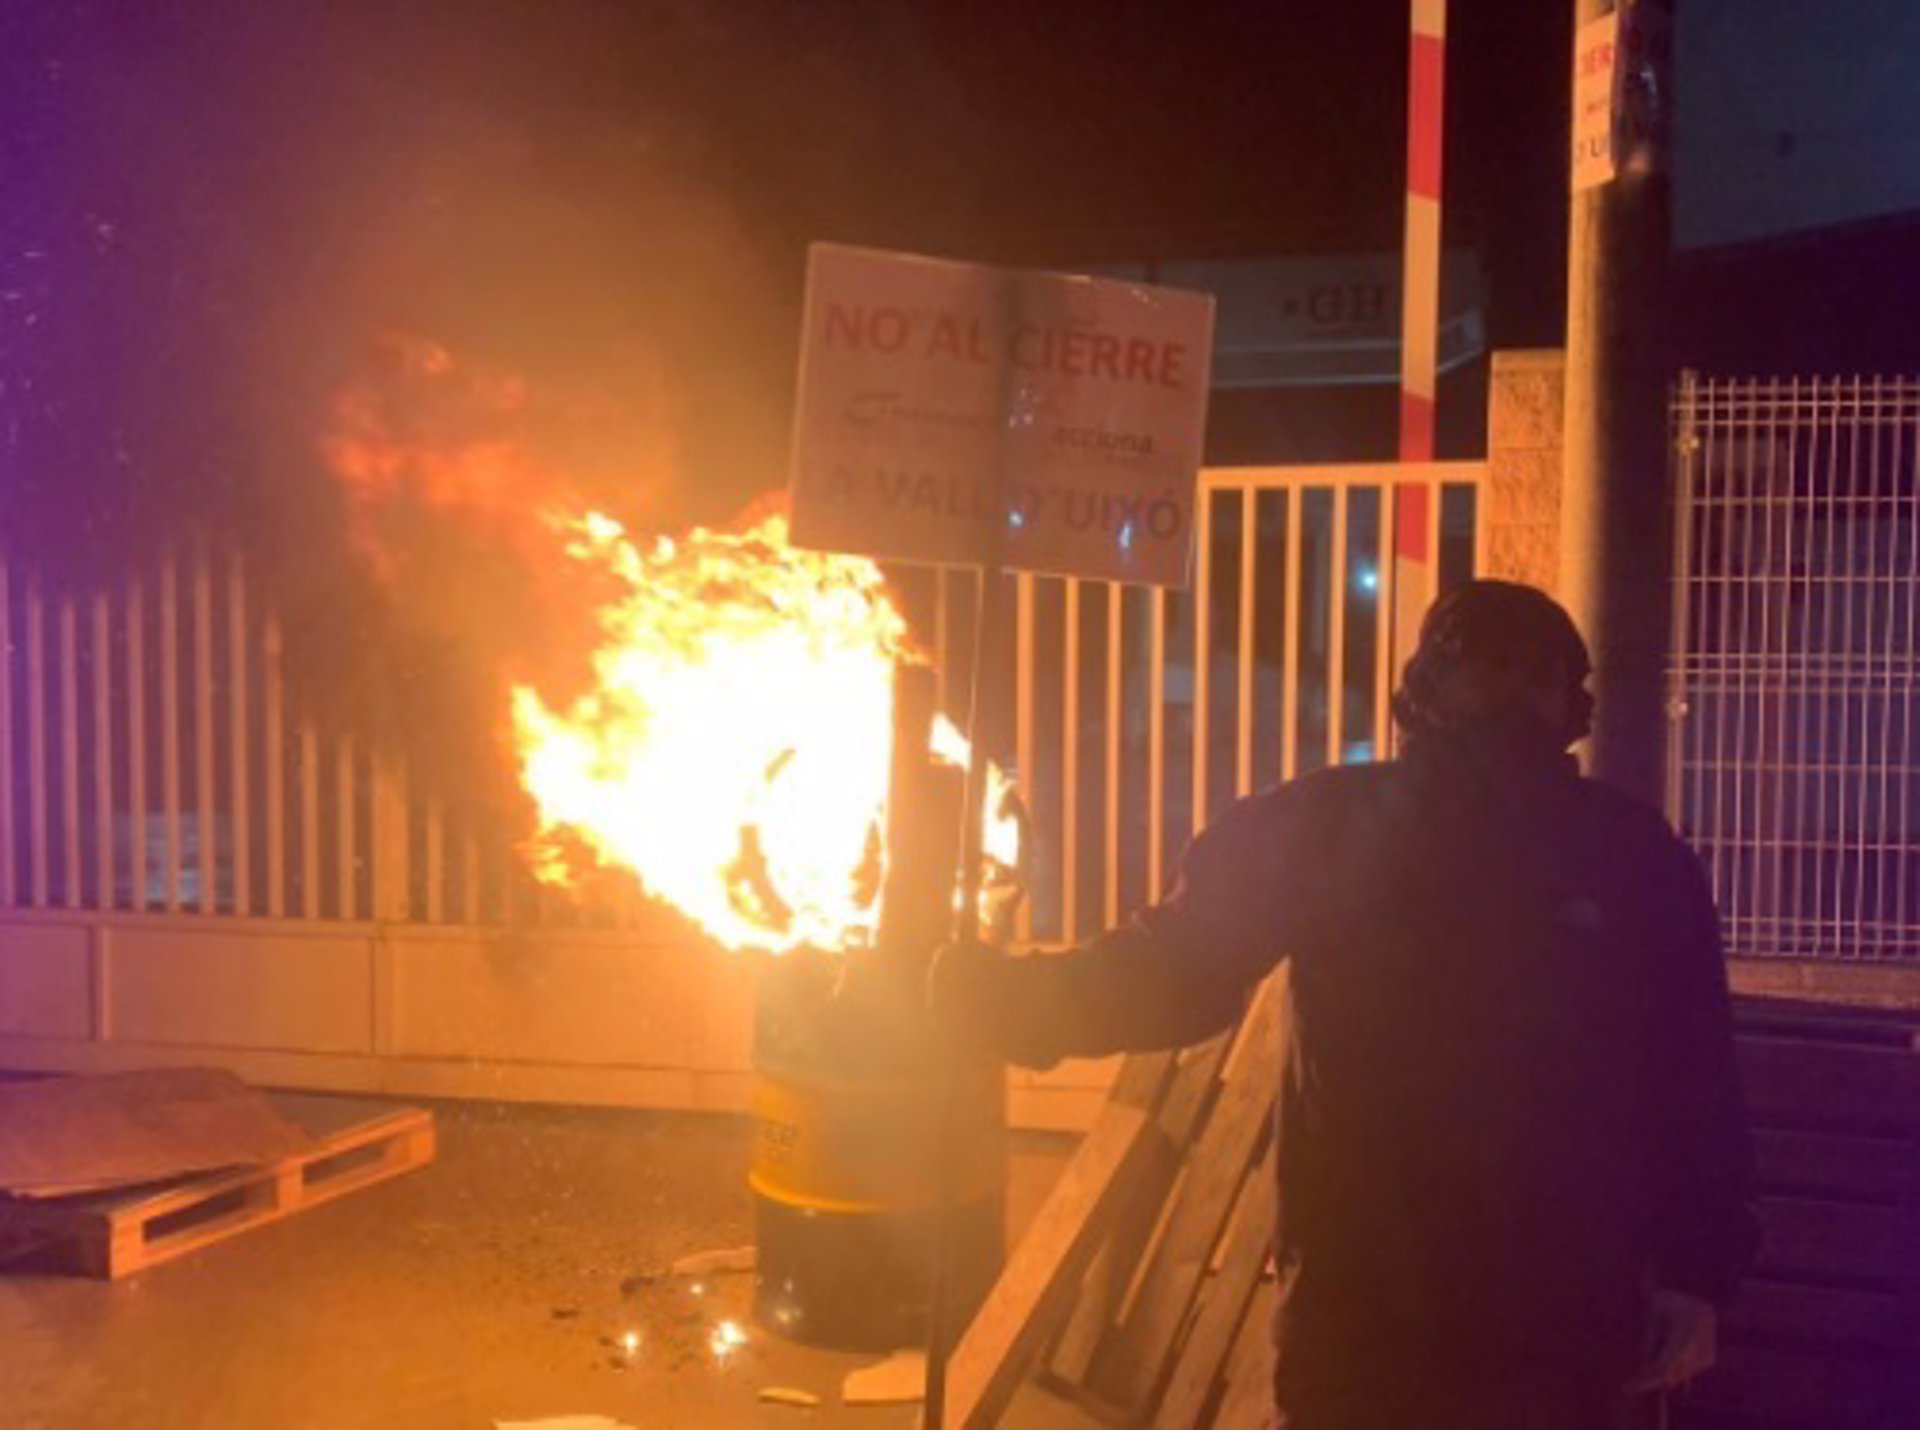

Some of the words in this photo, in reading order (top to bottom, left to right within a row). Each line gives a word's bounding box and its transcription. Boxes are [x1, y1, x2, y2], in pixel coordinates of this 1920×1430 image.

[822, 302, 909, 355] NO
[924, 313, 992, 364] AL
[1006, 321, 1189, 389] CIERRE
